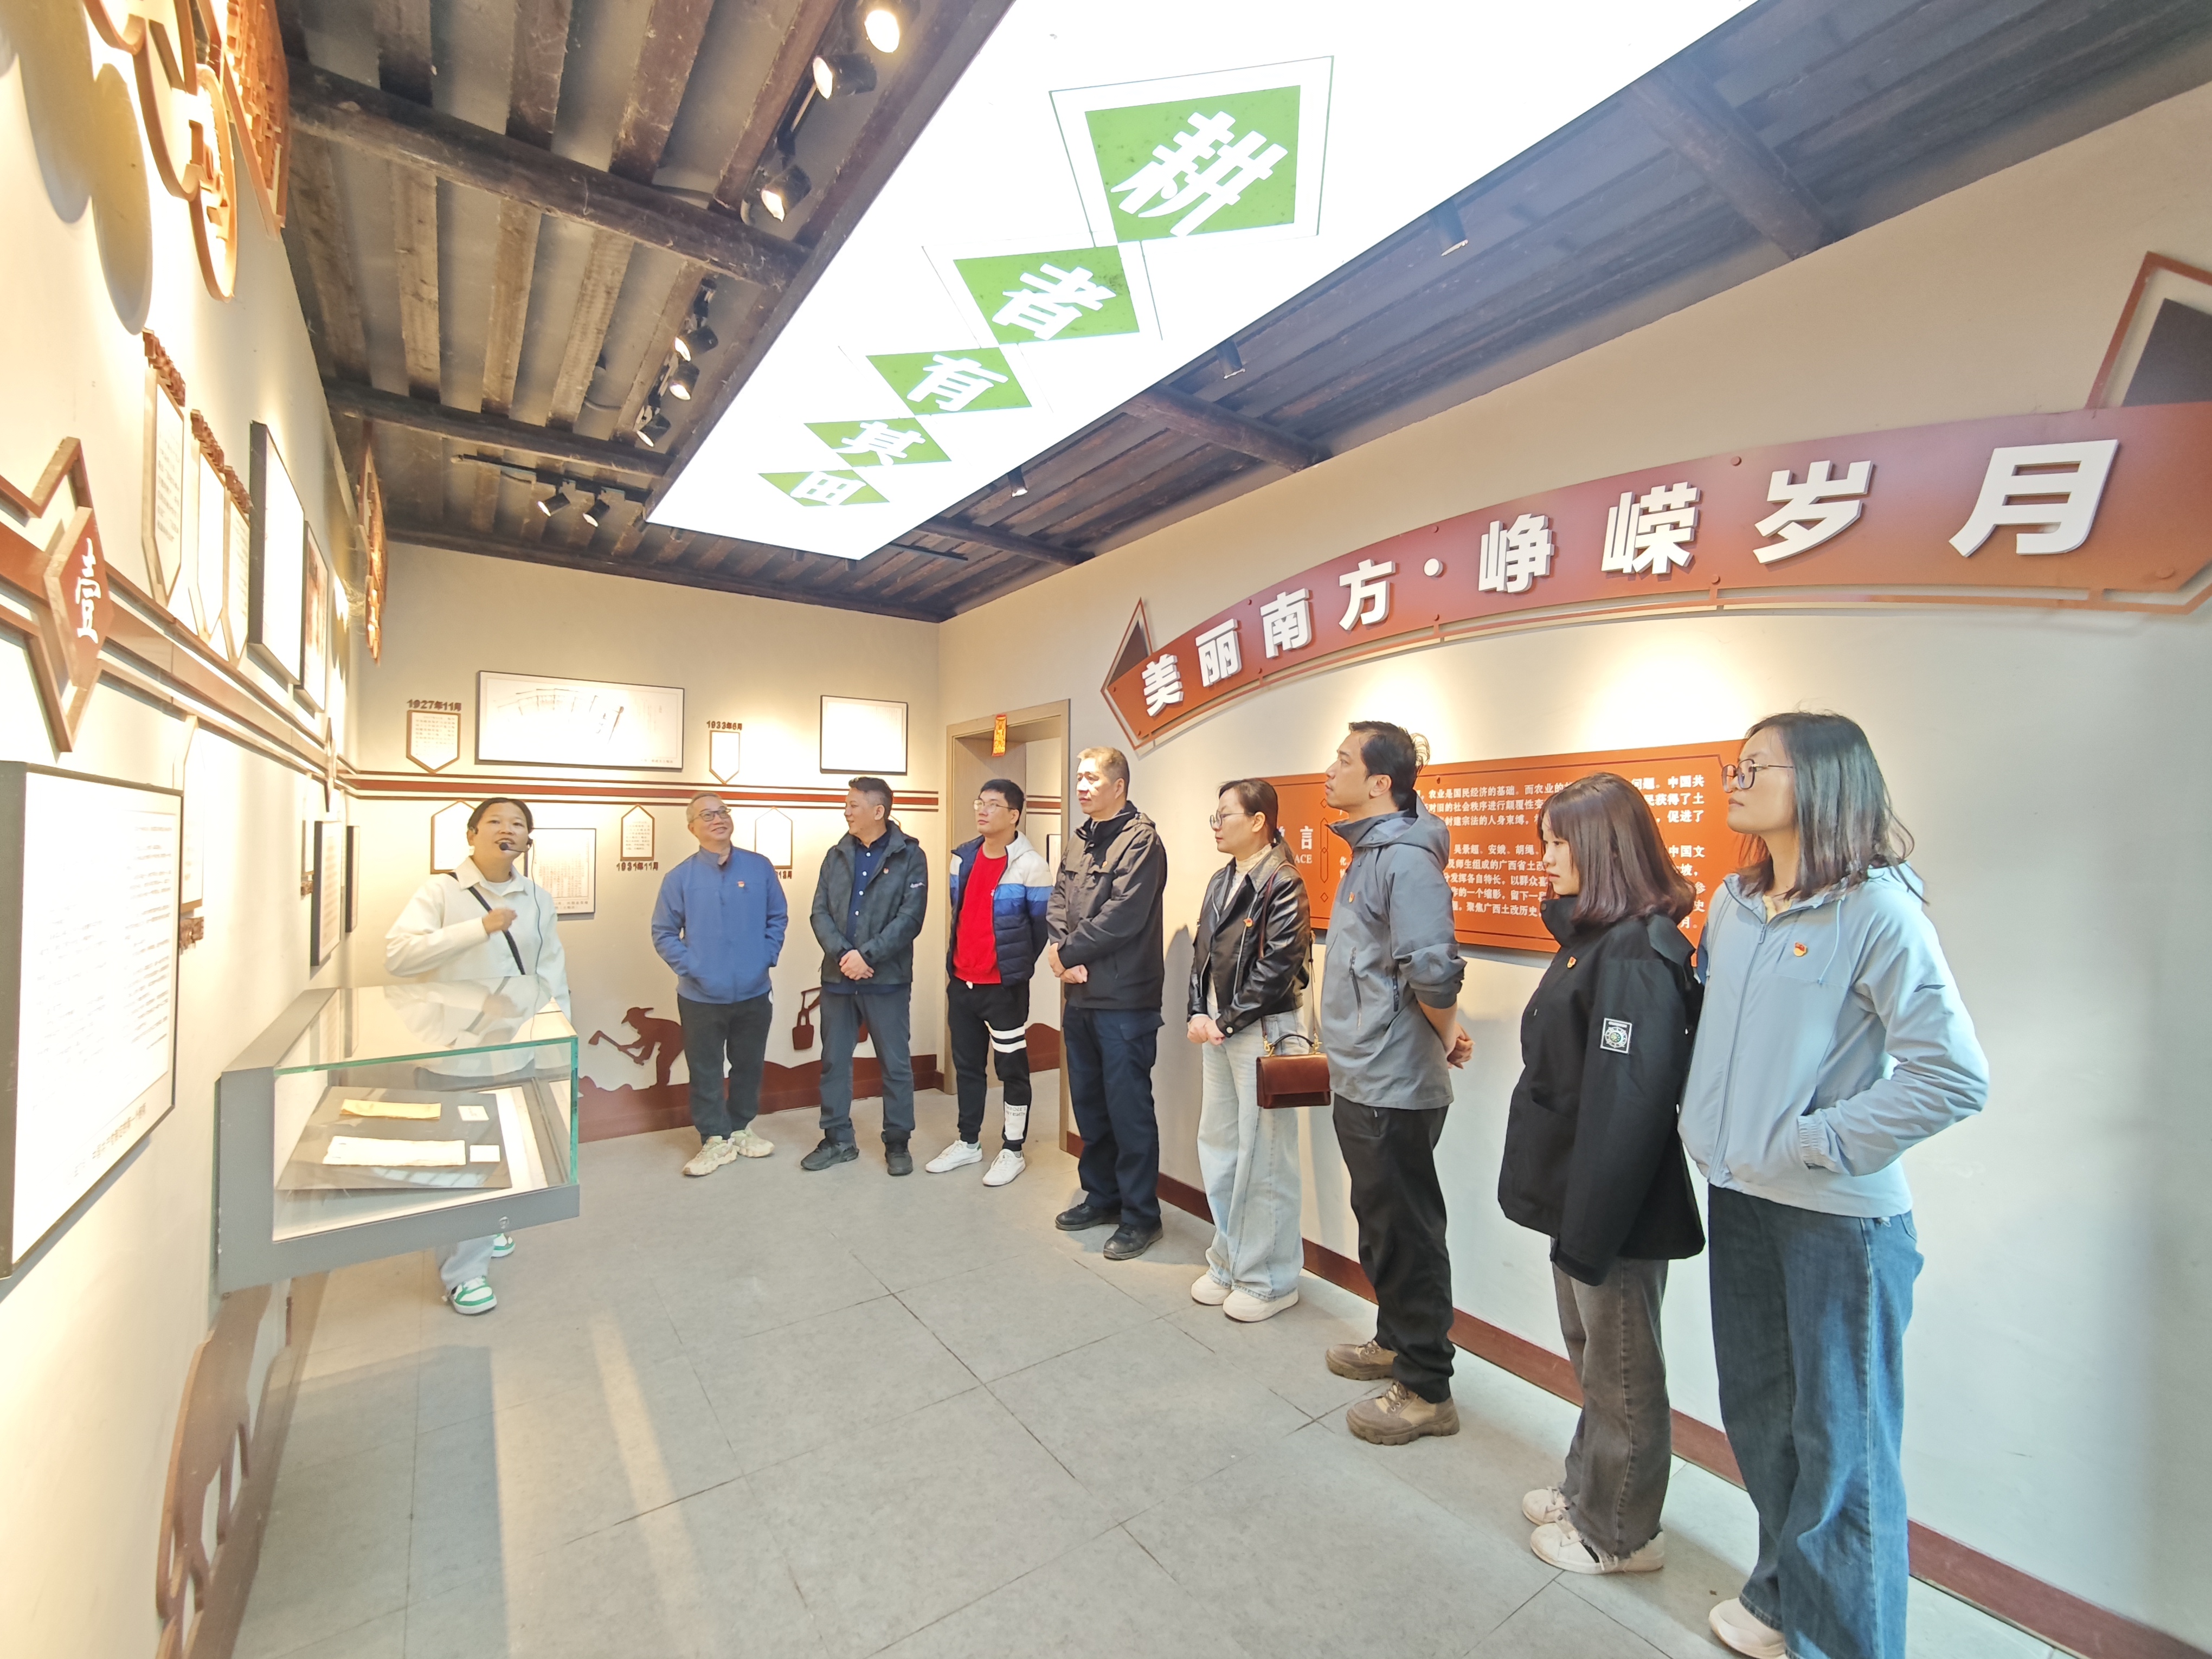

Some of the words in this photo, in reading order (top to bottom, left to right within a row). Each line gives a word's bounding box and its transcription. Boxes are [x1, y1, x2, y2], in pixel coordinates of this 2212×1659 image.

[789, 110, 1288, 506] 耕者有其田
[1141, 439, 2120, 717] 美丽南方·峥嵘岁月
[407, 698, 461, 711] 1927年11月
[1668, 845, 1706, 858] 中国文
